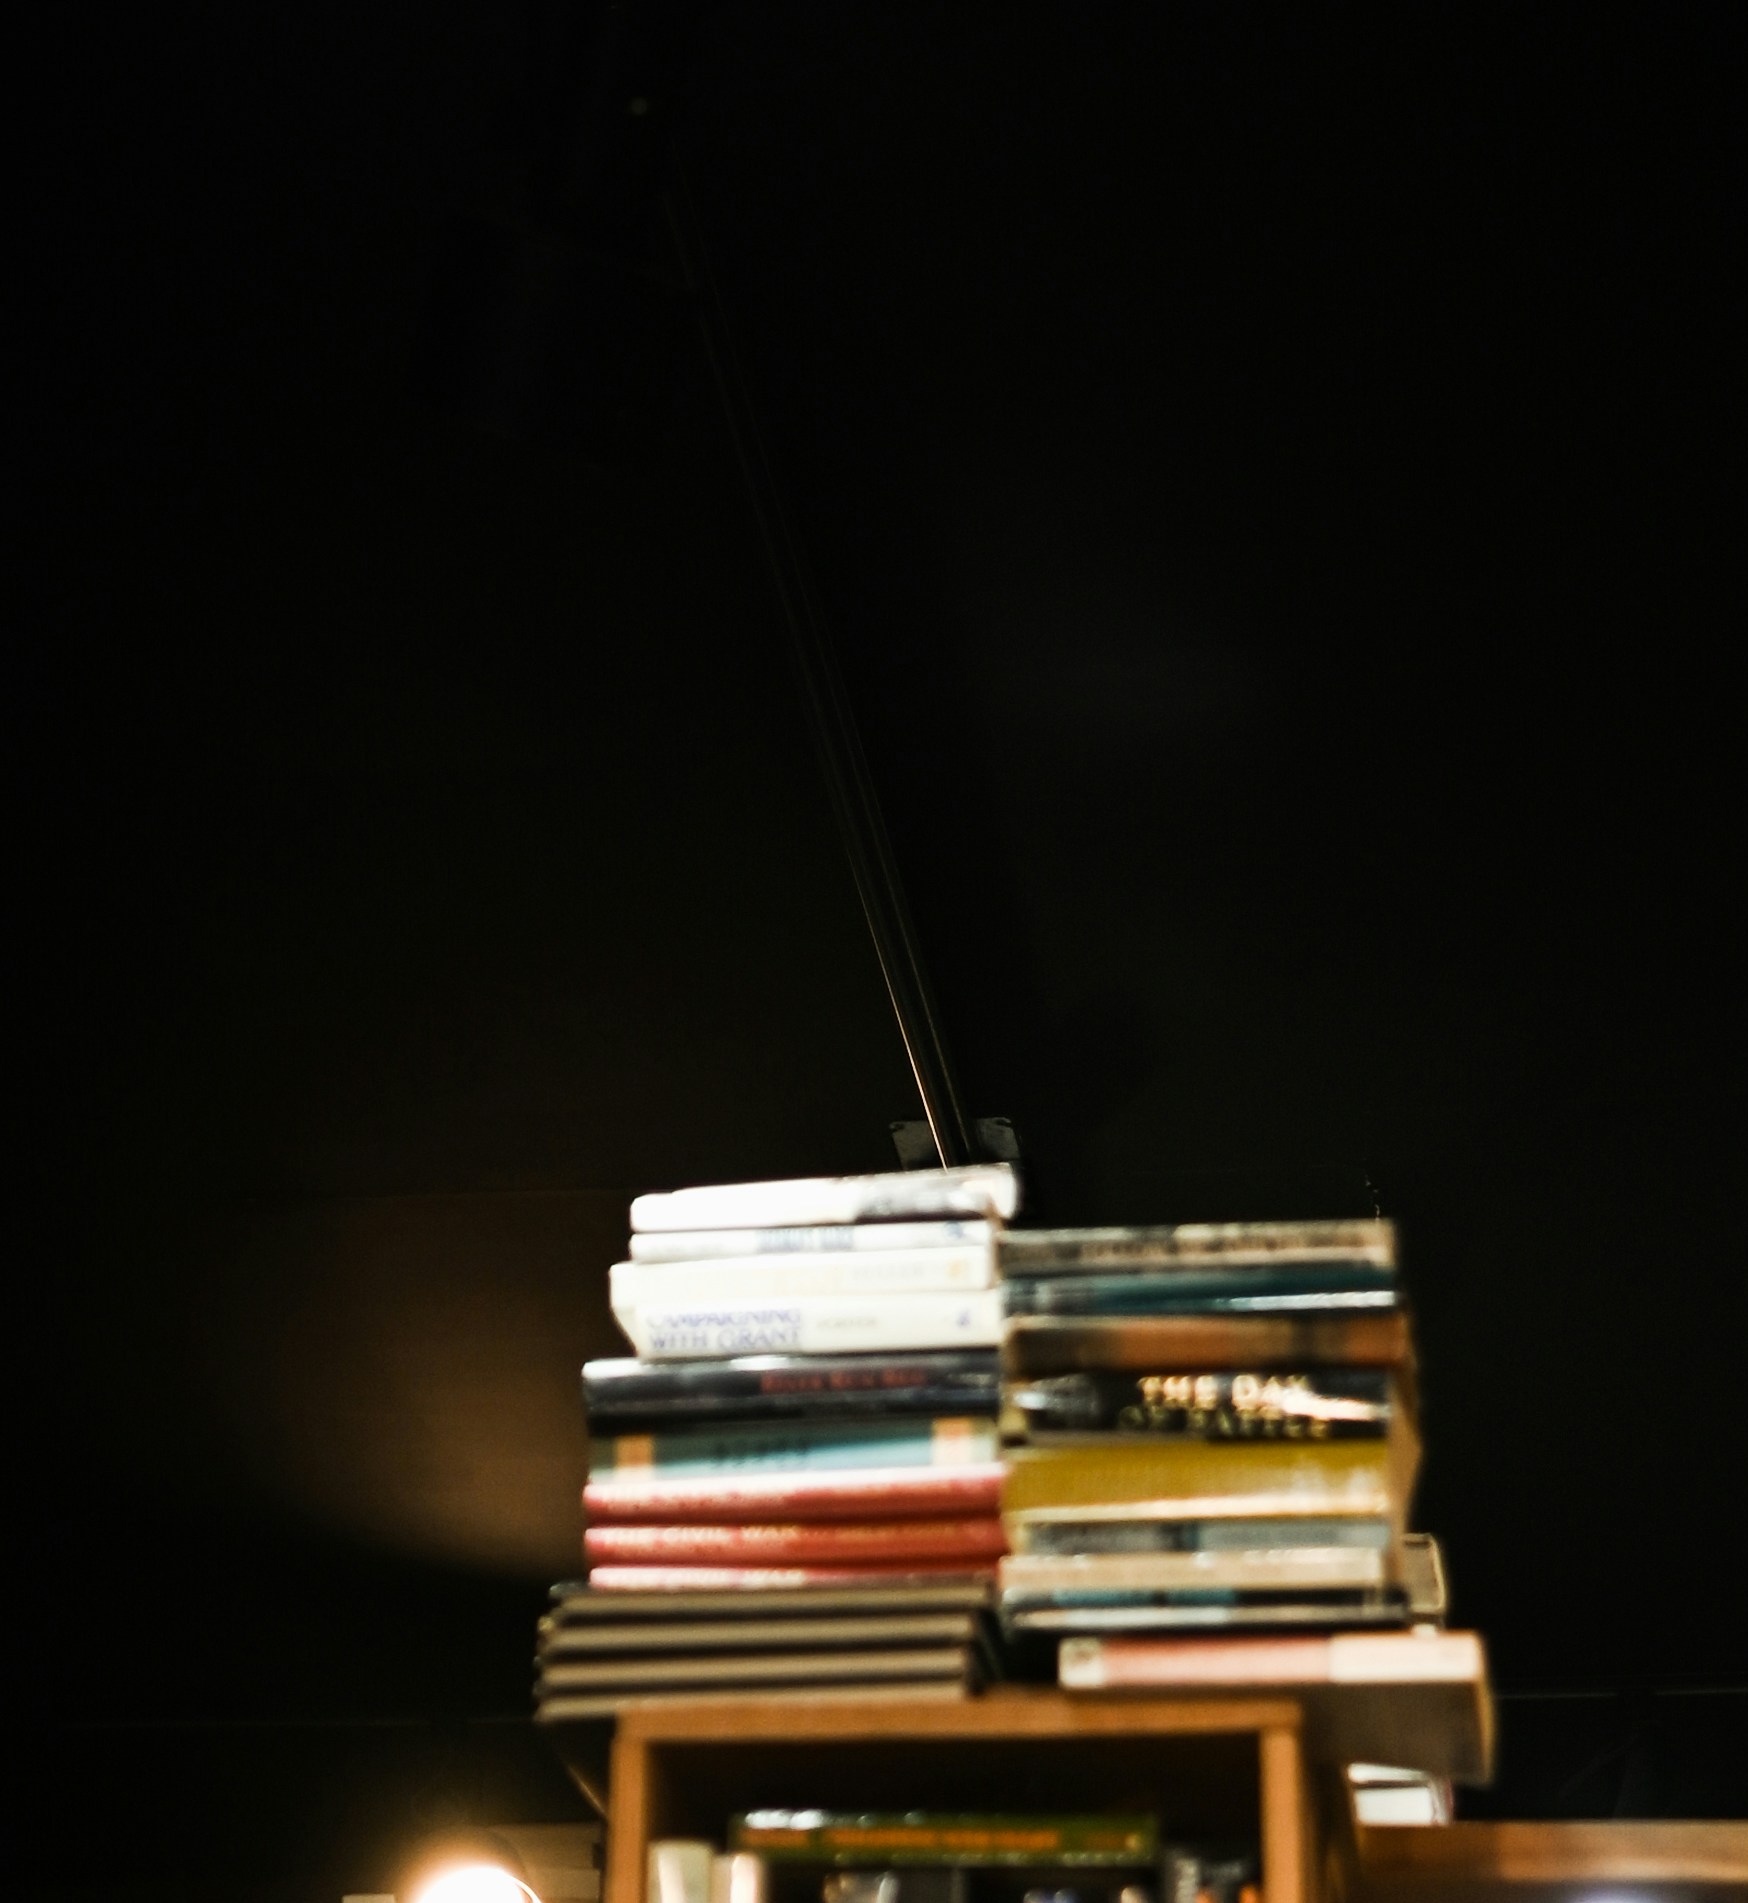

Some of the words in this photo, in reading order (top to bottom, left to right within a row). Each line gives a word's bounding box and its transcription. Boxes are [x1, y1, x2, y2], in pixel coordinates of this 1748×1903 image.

[651, 1330, 711, 1350] WITH
[717, 1328, 802, 1350] GRANT
[1138, 1374, 1220, 1410] THE
